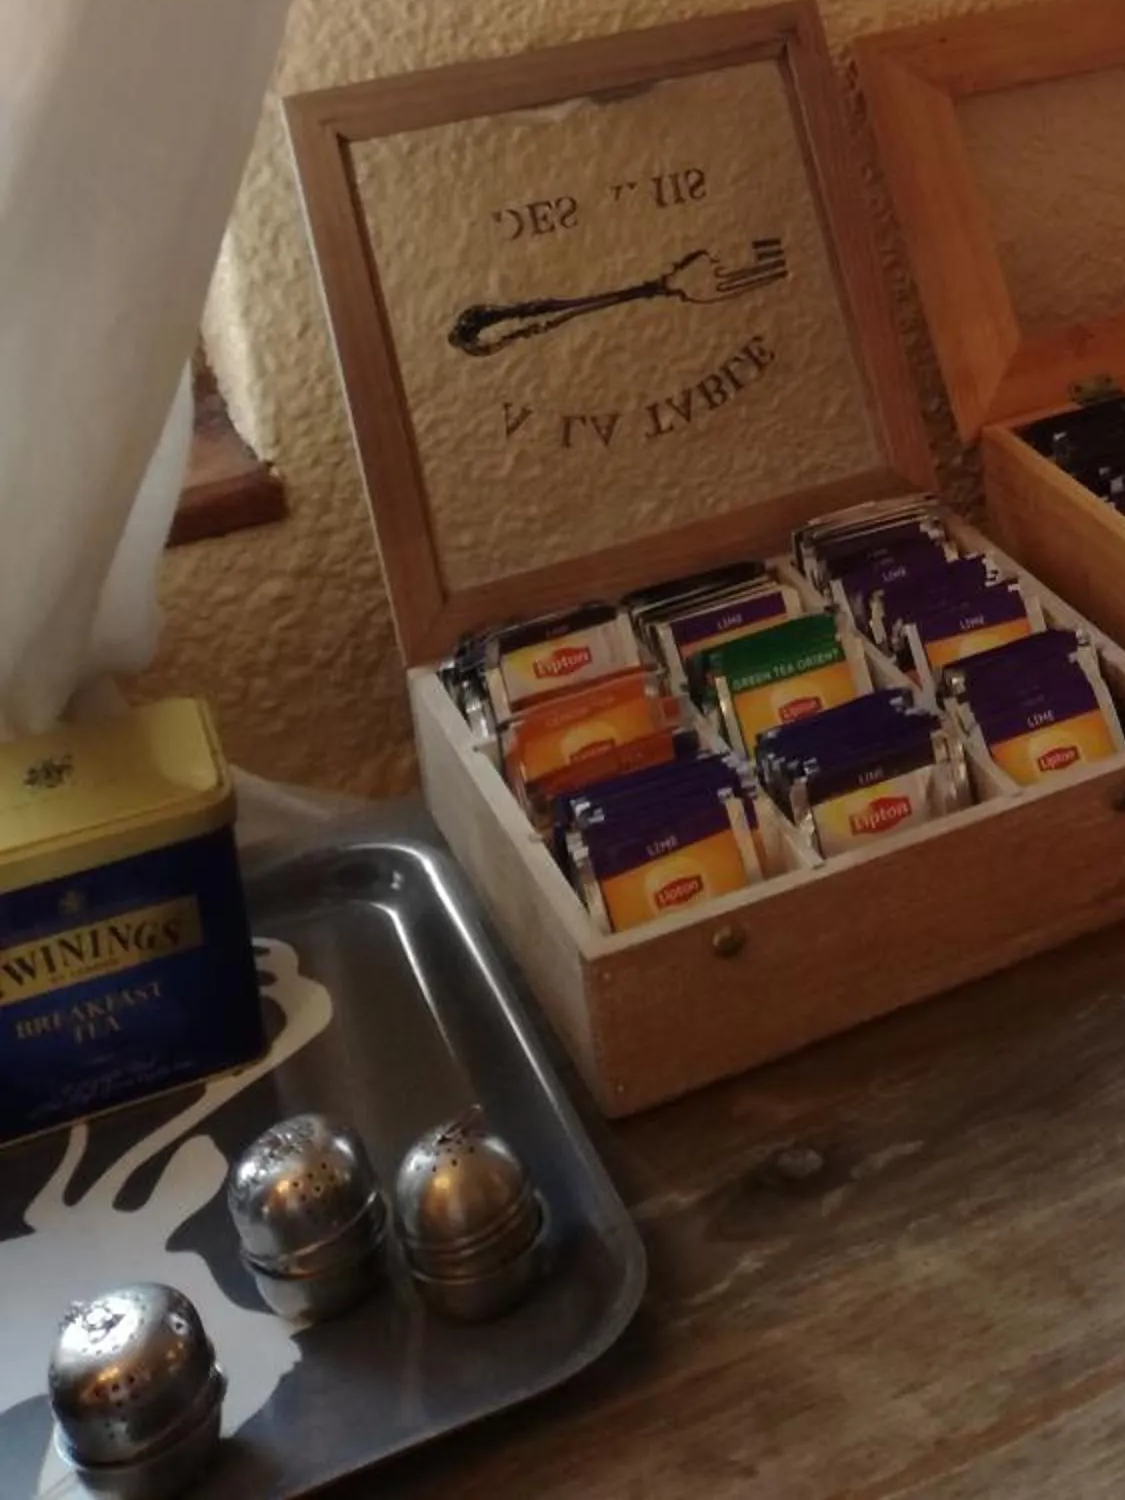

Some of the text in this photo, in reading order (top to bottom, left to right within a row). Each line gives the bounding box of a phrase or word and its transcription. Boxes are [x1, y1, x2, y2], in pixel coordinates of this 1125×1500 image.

[535, 647, 591, 678] Lipton
[852, 797, 911, 832] Lipton
[656, 878, 701, 907] Lipton
[0, 917, 182, 995] WININGS
